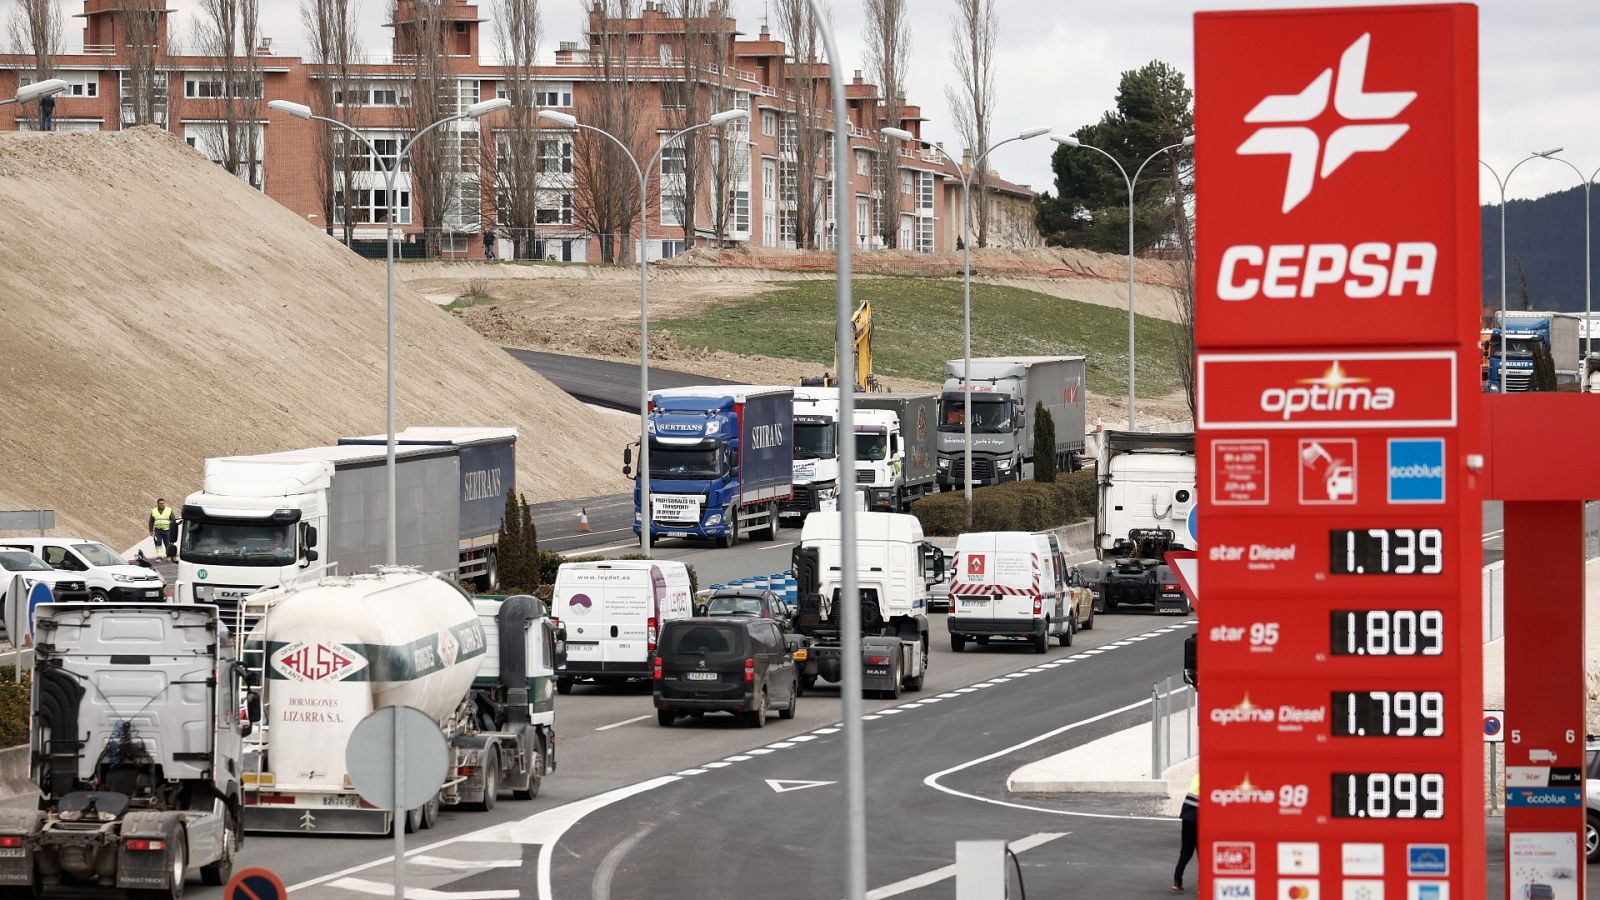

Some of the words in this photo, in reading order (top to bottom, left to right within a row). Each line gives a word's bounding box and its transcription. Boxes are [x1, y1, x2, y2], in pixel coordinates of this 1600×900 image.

[1216, 241, 1438, 301] CEPSA
[1260, 384, 1396, 421] optima
[1390, 463, 1442, 478] ecoblue
[1210, 545, 1244, 560] star
[1248, 544, 1296, 560] Diesel
[1347, 528, 1442, 574] 1.739
[1210, 626, 1246, 641] star
[1250, 622, 1280, 646] 95
[1348, 610, 1442, 656] 1.809
[281, 666, 304, 683] PLANTA
[289, 697, 338, 707] HORMIGONES
[283, 711, 325, 722] LIZARRA
[327, 712, 343, 723] S.A.
[1210, 707, 1274, 726] optima
[1278, 706, 1325, 722] Diesel
[1348, 692, 1442, 737] 1.799
[1512, 730, 1520, 744] 5
[1566, 730, 1575, 744] 6
[1210, 788, 1274, 807] optima
[1278, 784, 1308, 808] 98
[1348, 773, 1442, 818] 1.899
[1526, 794, 1566, 803] ecoblue
[1221, 884, 1250, 897] VISA
